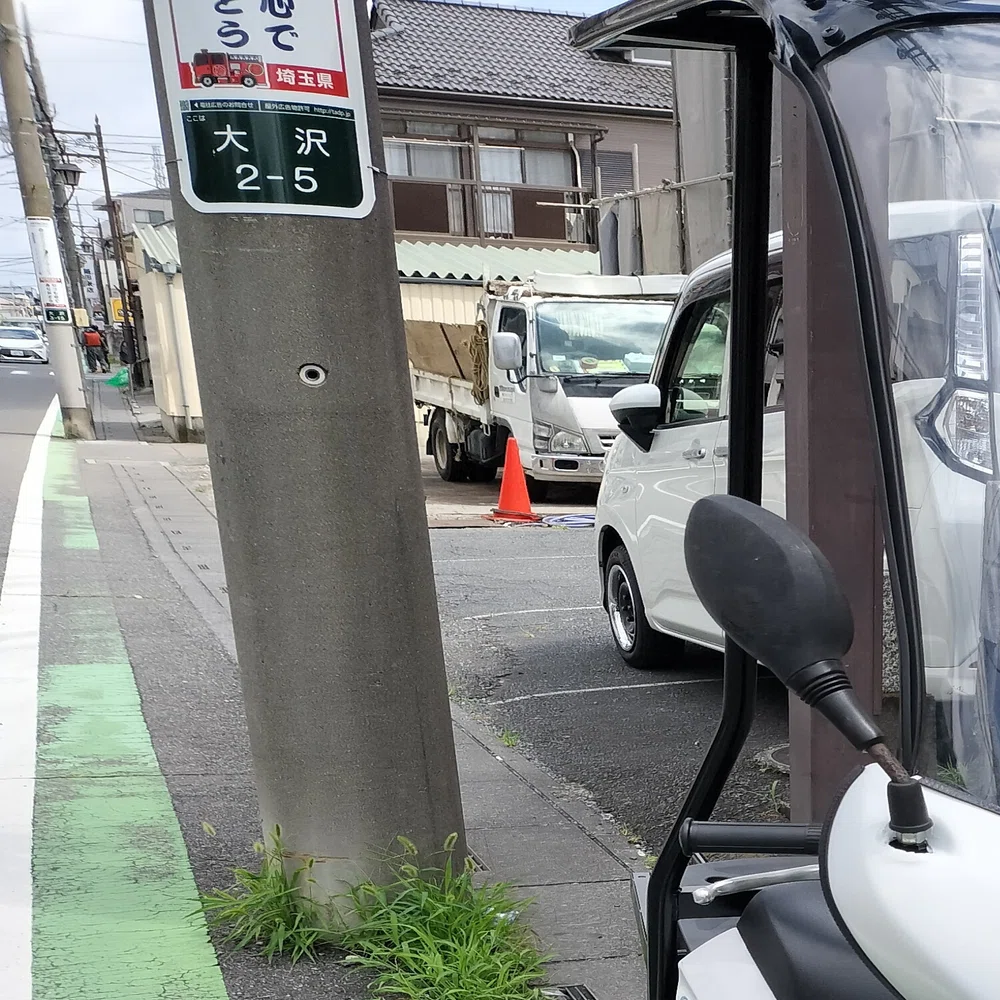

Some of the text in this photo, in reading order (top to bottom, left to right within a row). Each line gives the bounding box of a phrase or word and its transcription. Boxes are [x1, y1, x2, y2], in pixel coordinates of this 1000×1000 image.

[276, 67, 334, 90] 埼玉県
[235, 164, 319, 193] 2-5
